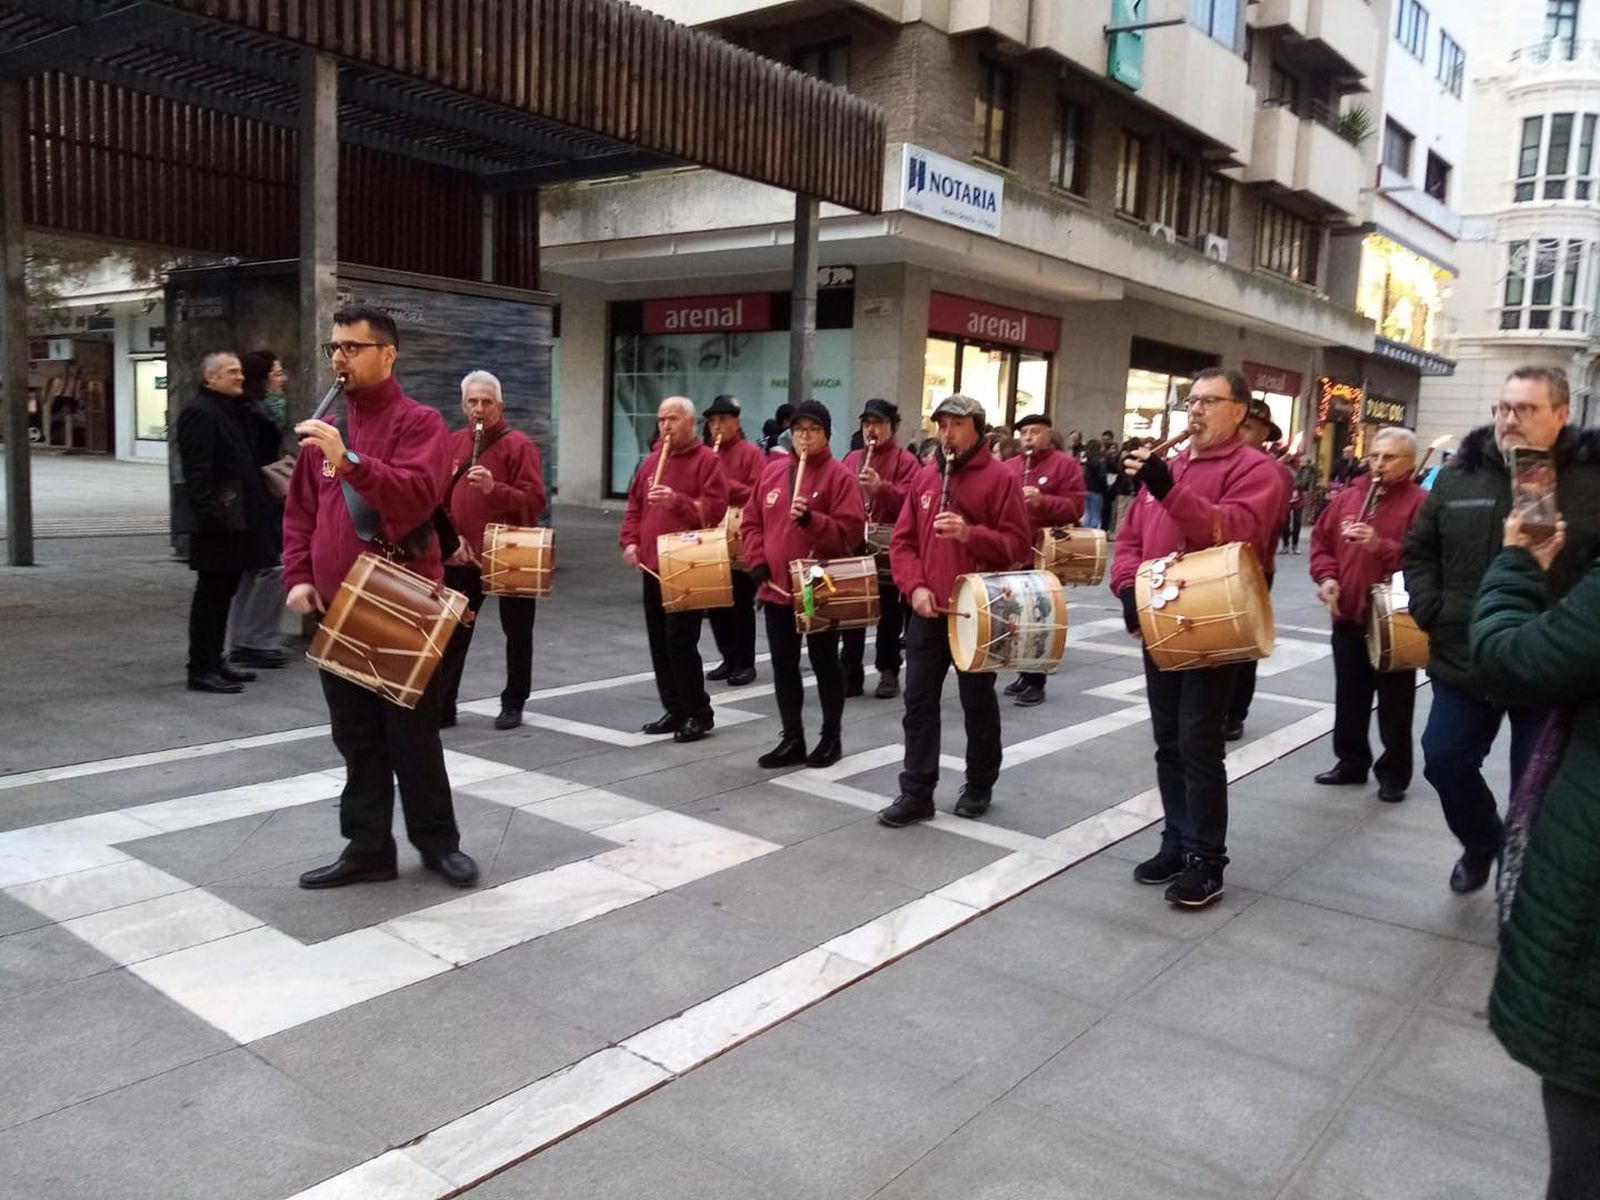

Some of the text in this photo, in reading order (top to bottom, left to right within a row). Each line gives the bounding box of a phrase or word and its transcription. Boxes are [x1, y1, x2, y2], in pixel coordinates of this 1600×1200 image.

[929, 171, 996, 213] NOTARIA
[665, 298, 743, 328] arenal
[967, 312, 1027, 342] arenal
